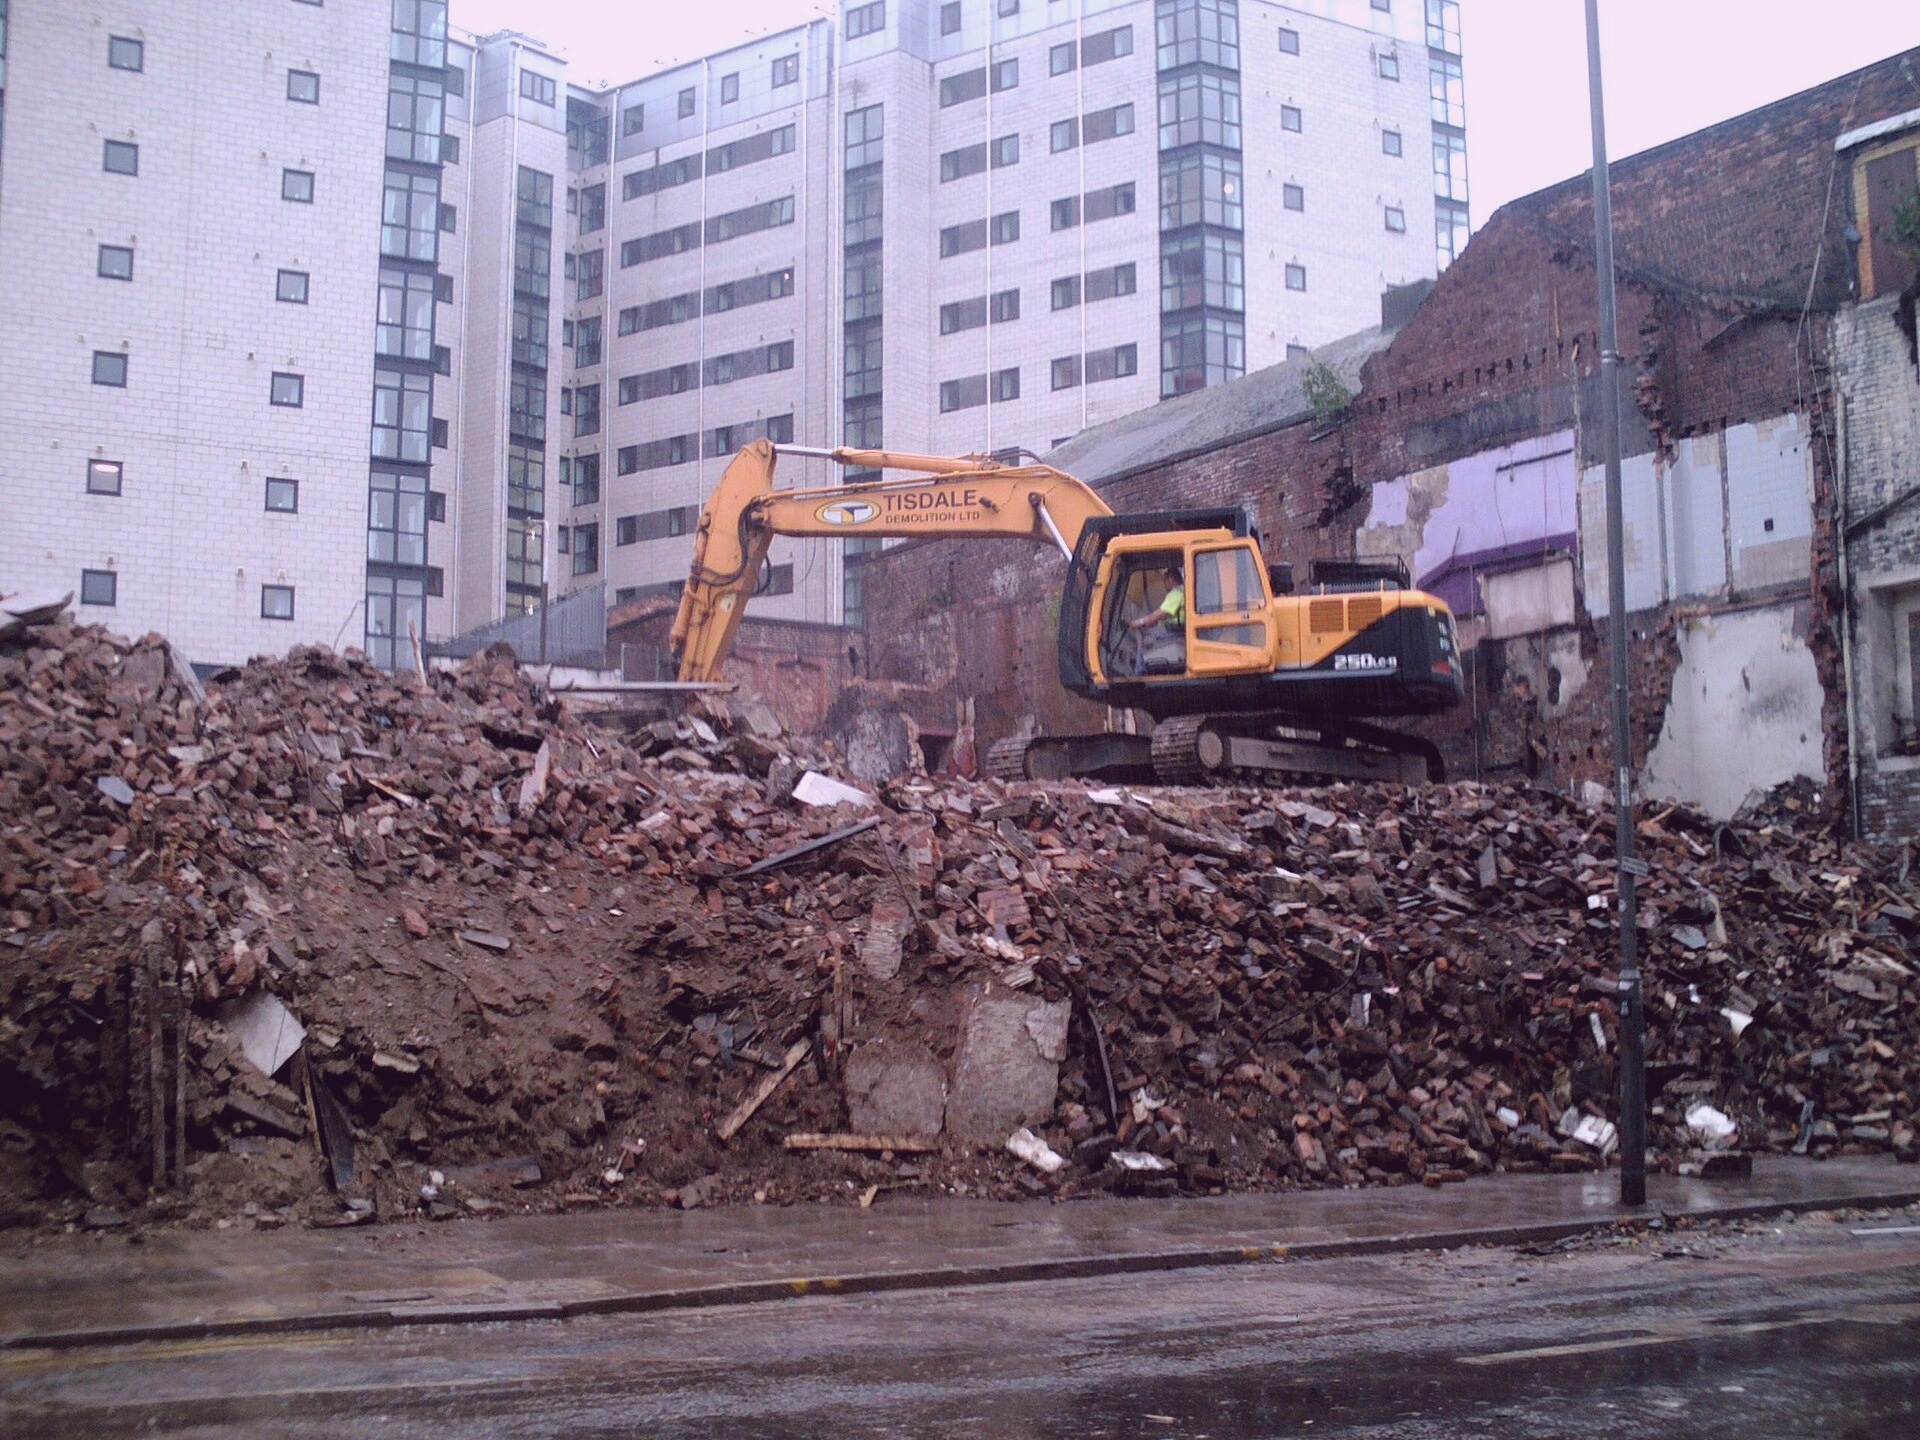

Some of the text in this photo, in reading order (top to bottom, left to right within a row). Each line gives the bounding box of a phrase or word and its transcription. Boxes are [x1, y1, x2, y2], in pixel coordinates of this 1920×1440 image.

[883, 489, 977, 511] TISDALE
[885, 511, 980, 524] DEMOLITION LTD
